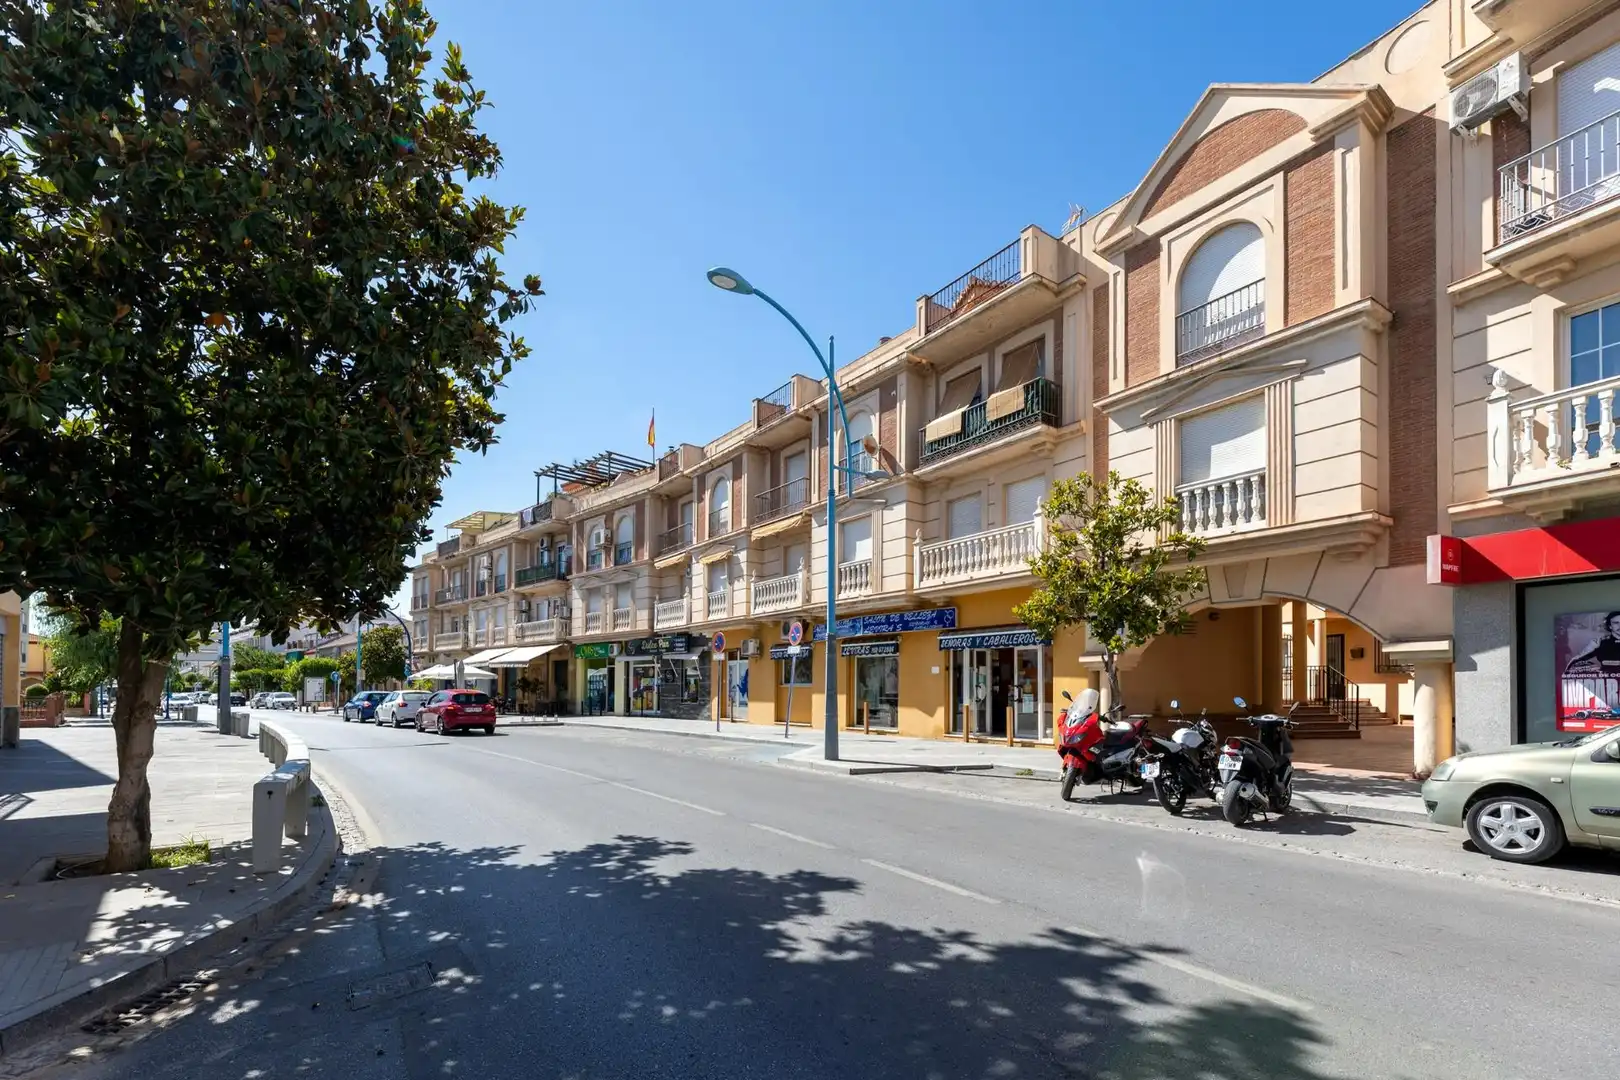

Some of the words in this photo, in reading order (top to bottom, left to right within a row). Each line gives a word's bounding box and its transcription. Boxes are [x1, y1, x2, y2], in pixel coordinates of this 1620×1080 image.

[1442, 564, 1459, 572] MAPFRE
[889, 614, 900, 622] DE
[975, 637, 982, 646] Y
[983, 632, 1036, 646] CABALLEROS
